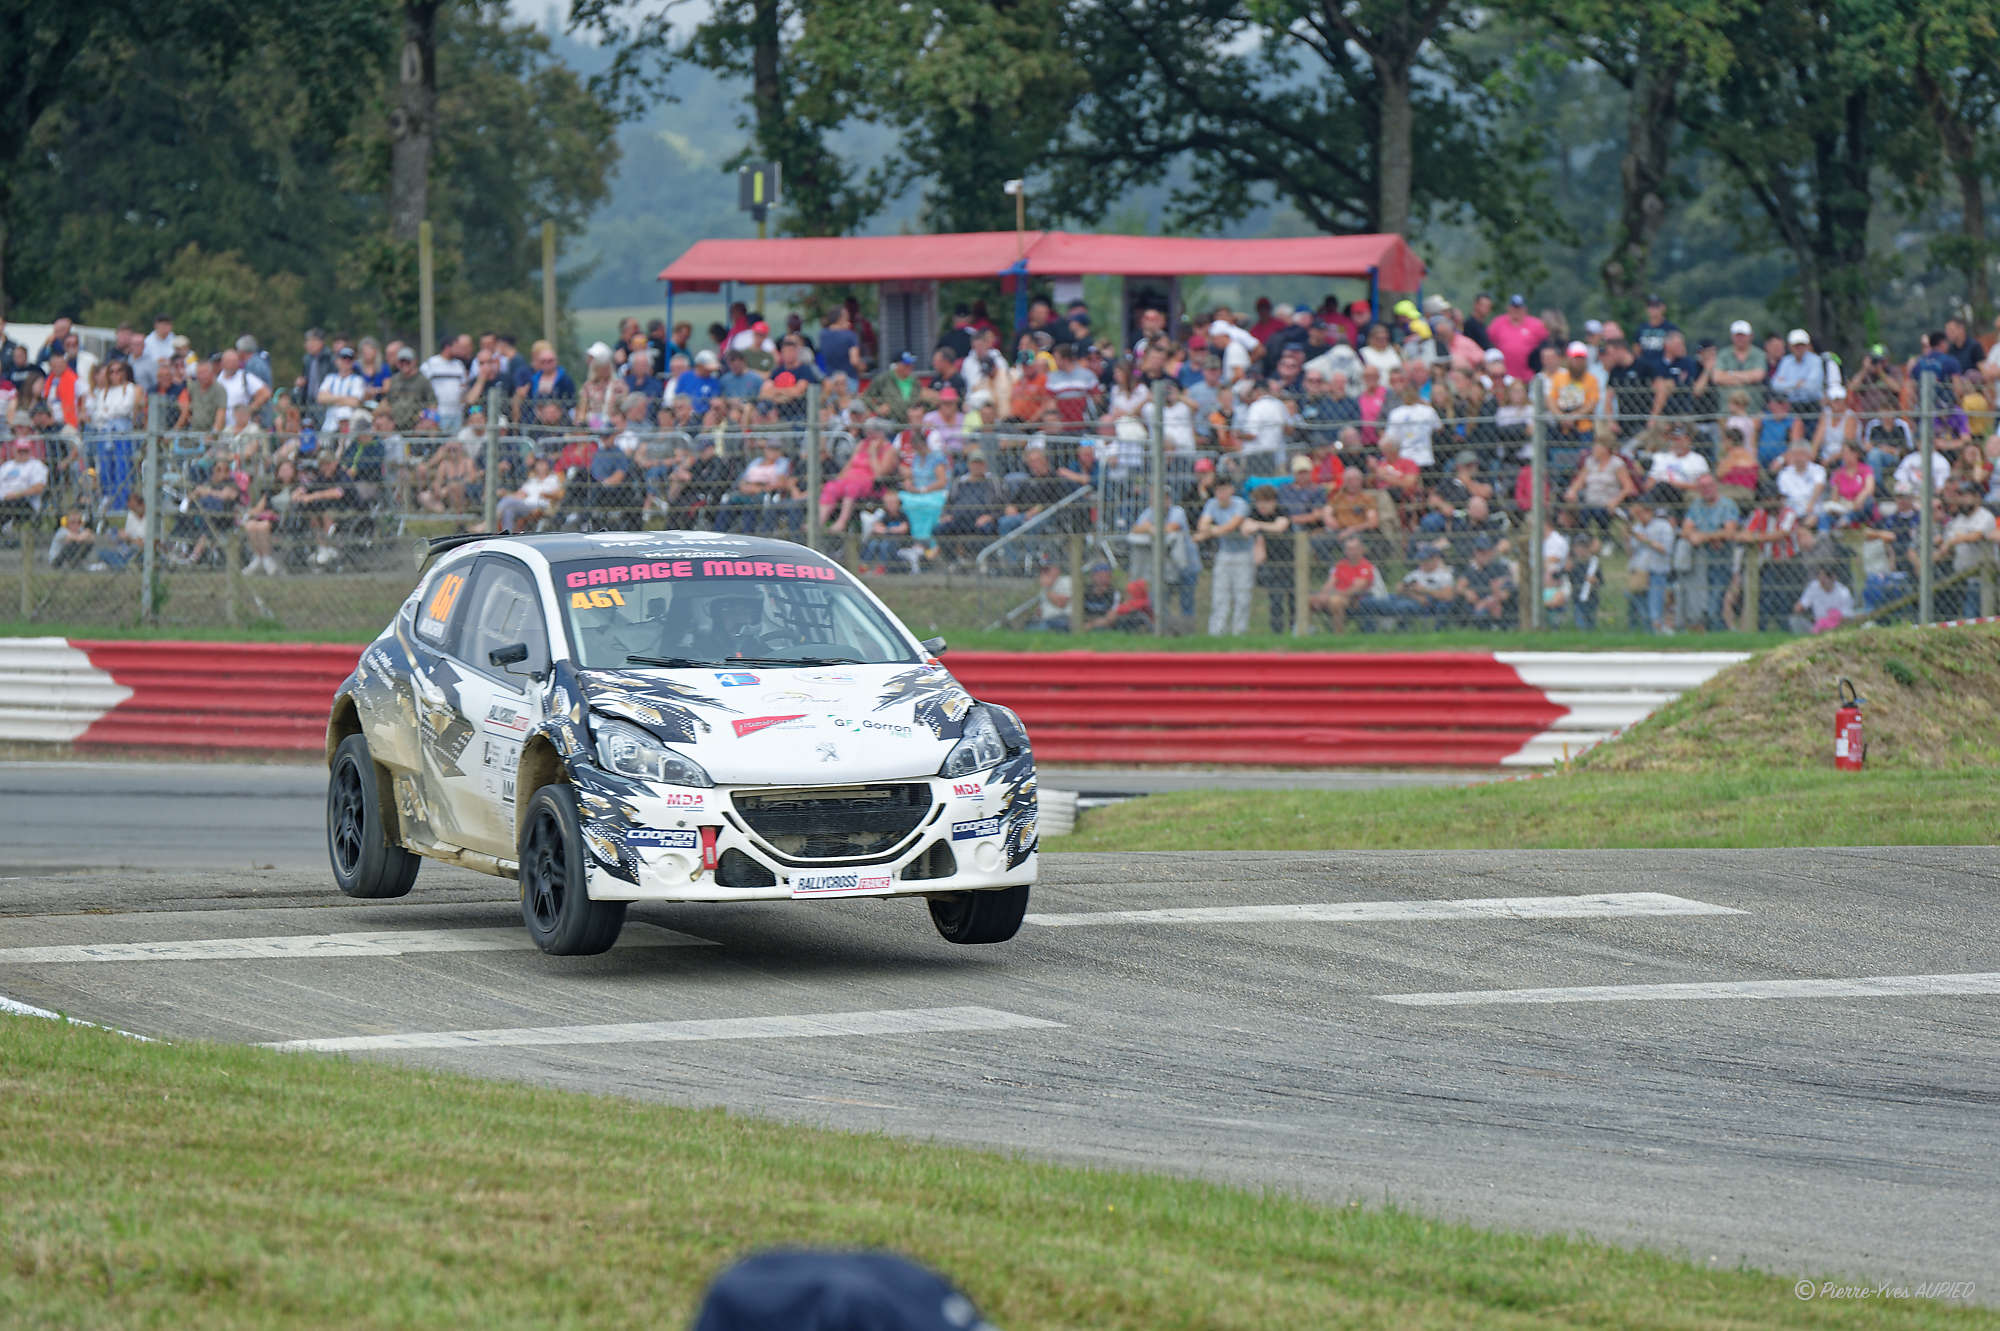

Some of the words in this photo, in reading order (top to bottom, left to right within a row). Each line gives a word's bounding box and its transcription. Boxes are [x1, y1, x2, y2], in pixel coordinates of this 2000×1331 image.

[566, 561, 693, 588] GARAGE
[703, 560, 837, 581] MOREAU
[429, 573, 464, 623] 461
[571, 588, 626, 610] 461
[862, 719, 912, 733] Gorron
[953, 818, 999, 833] COOPER
[626, 829, 696, 841] COOPER
[659, 839, 694, 847] TIRES
[798, 873, 859, 890] RALLYCROSS
